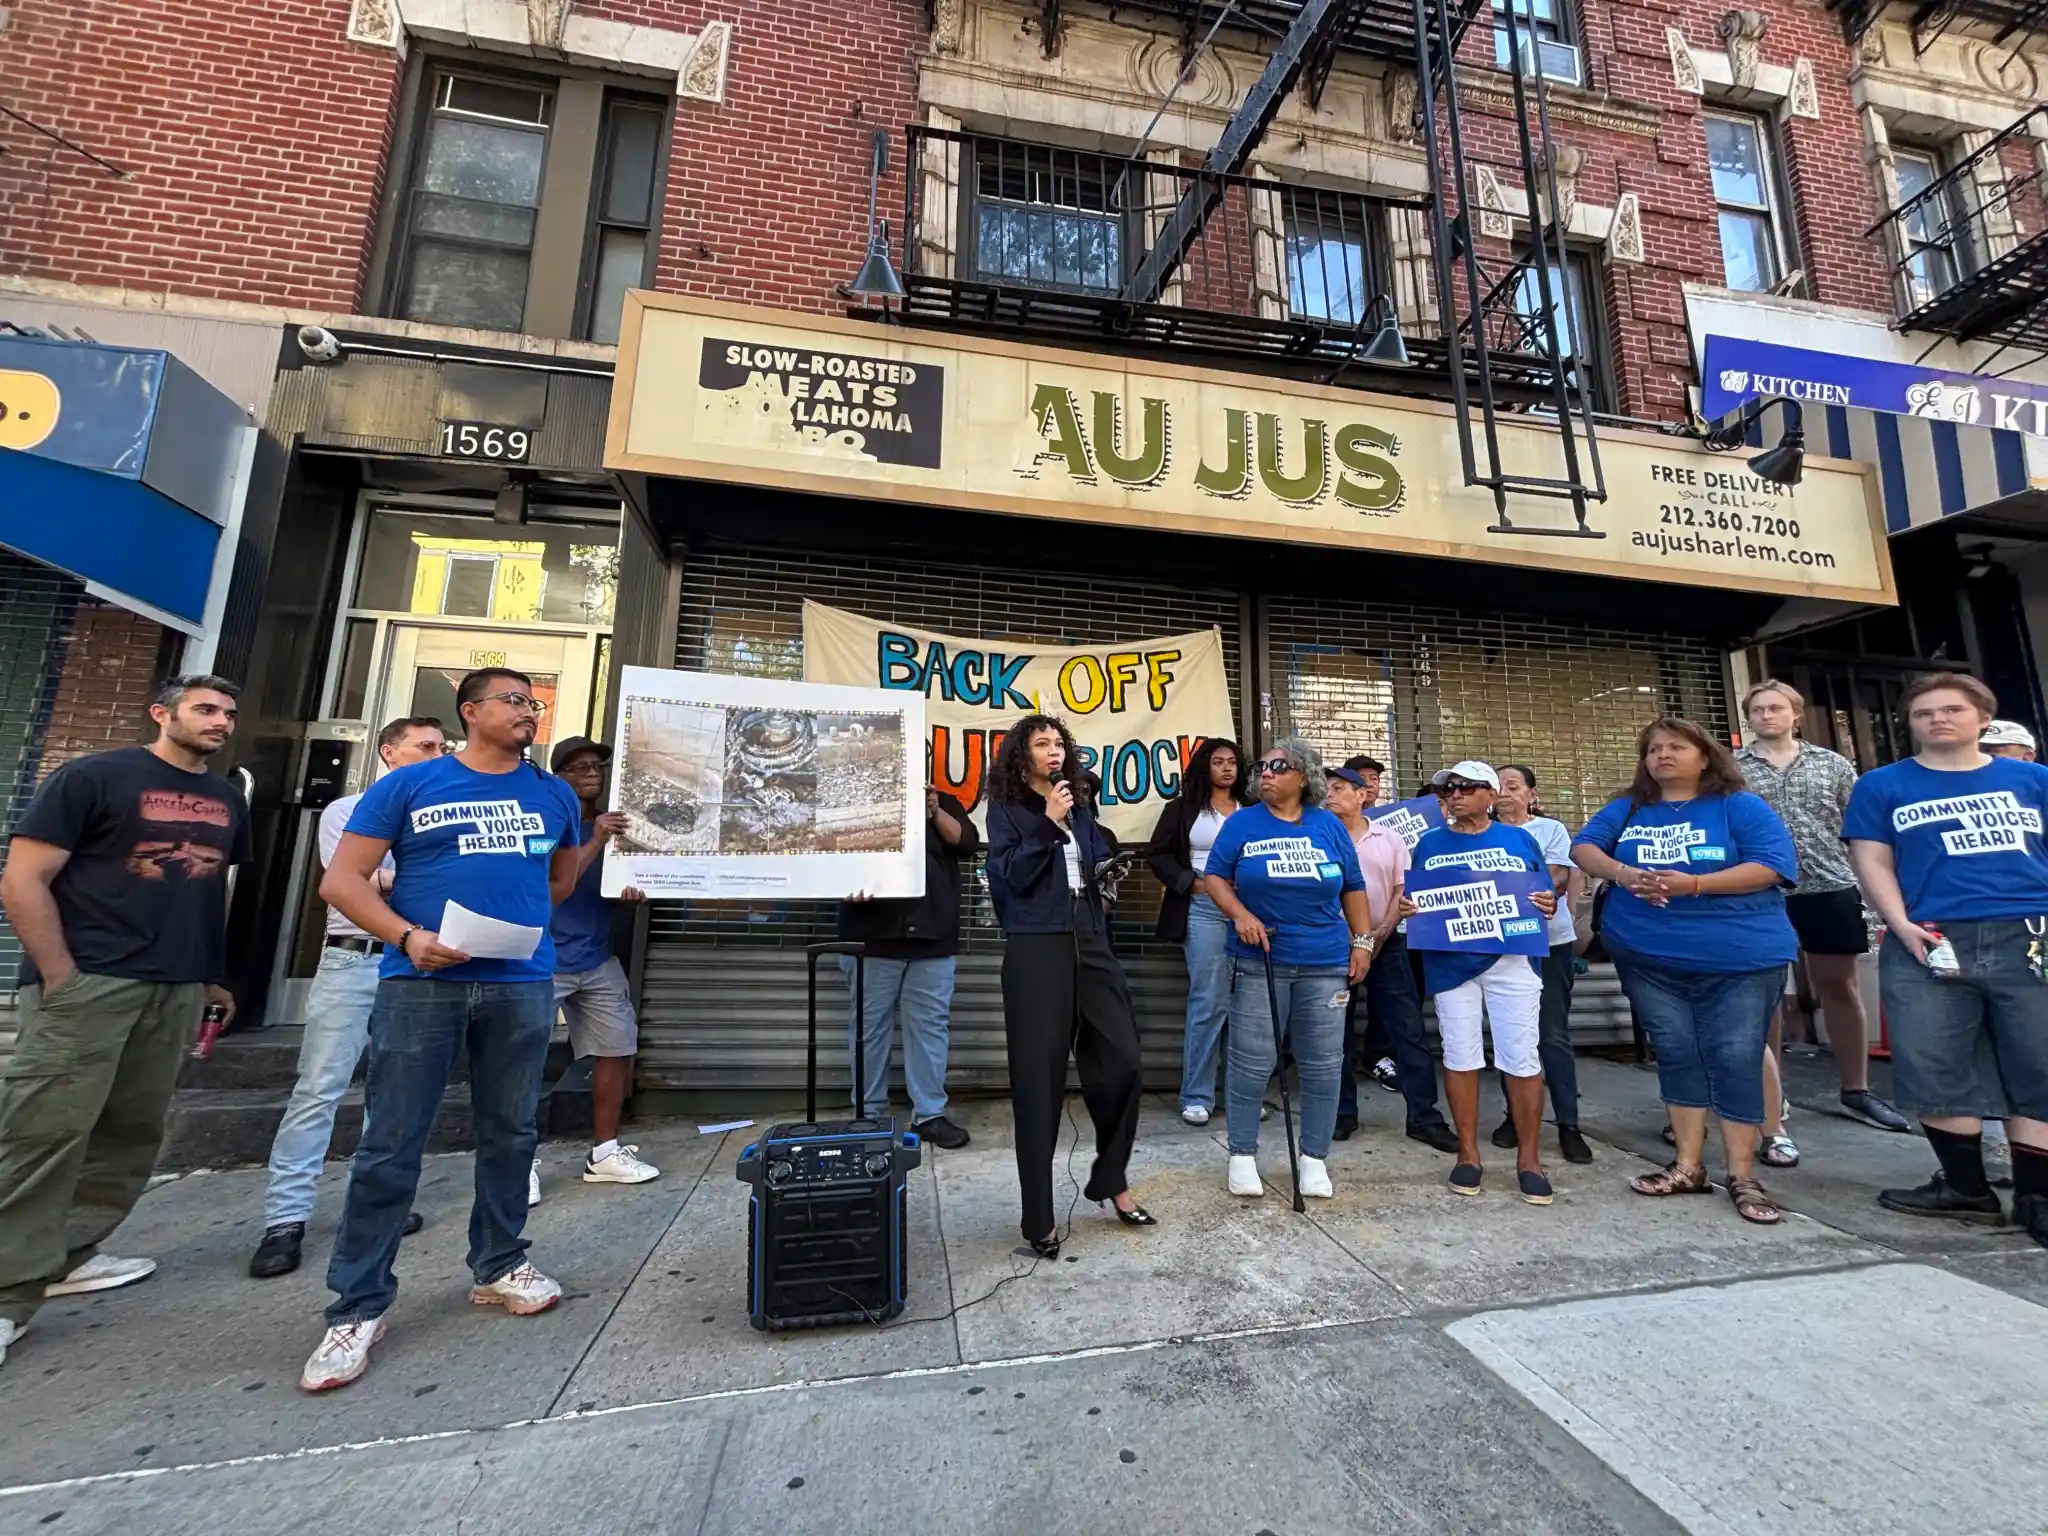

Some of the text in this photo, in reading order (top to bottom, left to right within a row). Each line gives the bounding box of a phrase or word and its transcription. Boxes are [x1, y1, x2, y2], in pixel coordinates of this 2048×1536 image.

[726, 345, 917, 385] SLOW-ROASTED
[747, 371, 898, 408] MEATS
[1752, 374, 1851, 404] KITCHEN
[444, 424, 529, 460] 1569
[1015, 384, 1405, 516] AU JUS
[1651, 464, 1697, 486] FREE
[1707, 491, 1750, 509] CALL
[1659, 504, 1801, 539] 212.360.7200
[1631, 530, 1837, 569] aujusharlem.com
[469, 651, 506, 668] 1569
[878, 631, 1182, 714] BACK OFF
[418, 804, 516, 827] COMMUNITY
[1897, 796, 2011, 826] COMMUNITY
[1969, 811, 2038, 830] VOICES
[483, 817, 540, 834] VOICES
[1395, 817, 1424, 835] OICES
[465, 835, 517, 850] HEARD
[1246, 840, 1308, 854] COMMUNITY
[1660, 832, 1700, 849] VOICES
[1951, 829, 2016, 850] HEARD
[1284, 851, 1324, 862] VOICES
[1428, 850, 1501, 867] COMMUNITY
[1643, 848, 1681, 860] HEARD
[1272, 862, 1312, 874] HEARD
[1476, 858, 1522, 870] VOICES
[1417, 885, 1492, 908] COMMUNITY
[1464, 899, 1512, 919] VOICES
[1451, 918, 1537, 937] HEARD POWER
